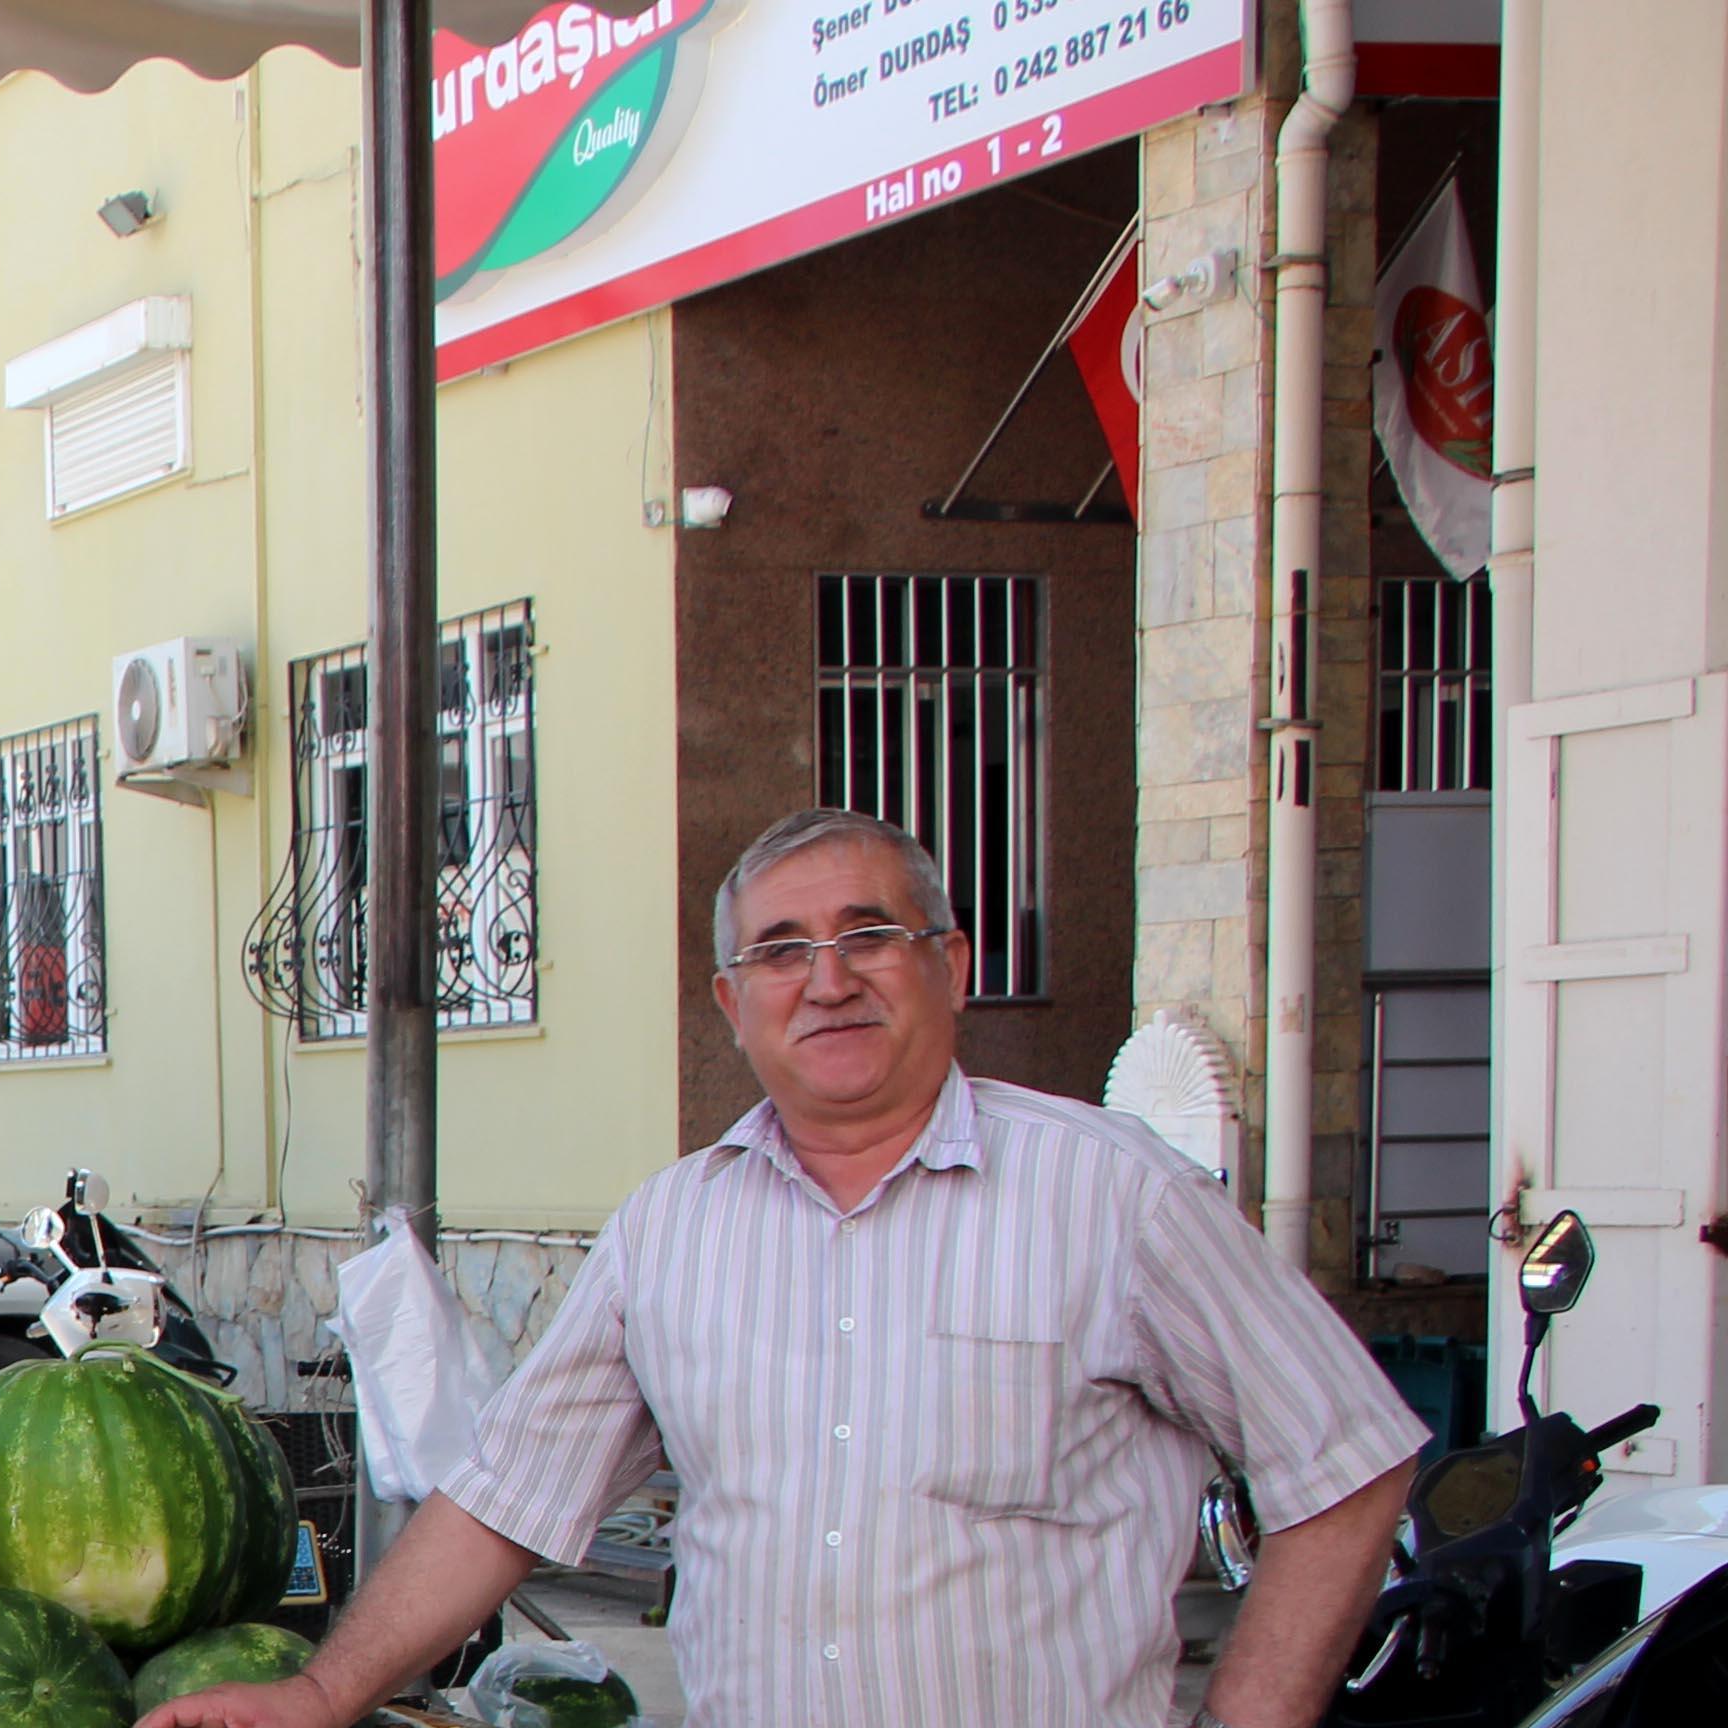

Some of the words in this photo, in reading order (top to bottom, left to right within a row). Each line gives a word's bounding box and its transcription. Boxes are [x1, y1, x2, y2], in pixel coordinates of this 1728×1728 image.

[811, 1, 873, 55] Şener
[813, 66, 869, 108] Ömer
[880, 16, 972, 80] DURDAŞ
[994, 1, 1008, 31] 0
[928, 81, 980, 123] TEL:
[994, 66, 1008, 97] 0
[1014, 45, 1059, 90] 242
[1065, 24, 1112, 69] 887
[1118, 9, 1148, 49] 21
[1157, 0, 1190, 32] 66
[573, 106, 641, 167] Quality
[867, 168, 915, 222] Hal
[923, 160, 963, 201] no
[987, 136, 1003, 176] 1
[1041, 114, 1064, 157] 2
